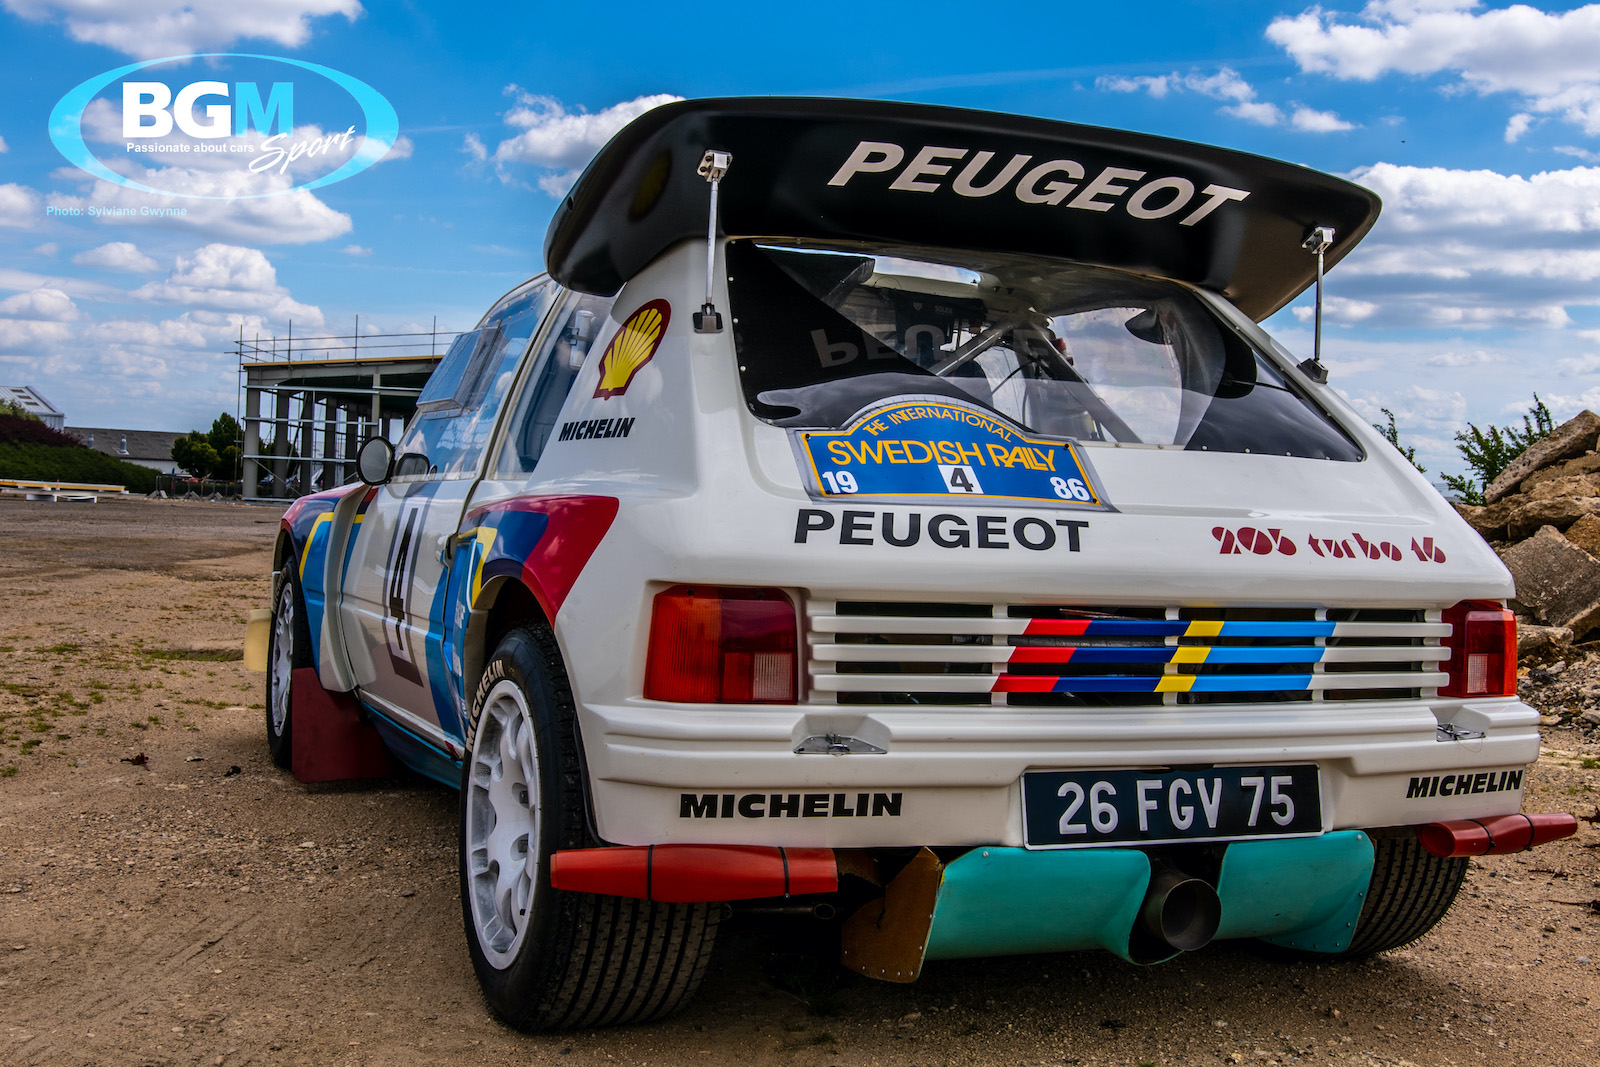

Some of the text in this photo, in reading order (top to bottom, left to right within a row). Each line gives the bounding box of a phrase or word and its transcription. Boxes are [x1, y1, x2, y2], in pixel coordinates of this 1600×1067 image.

[827, 140, 1251, 227] PEUGEOT
[558, 417, 636, 442] MICHELIN
[863, 407, 1013, 443] THE INTERNATIONAL
[827, 440, 1056, 472] SWEDISH RALLY
[821, 467, 1090, 502] 19 4 86
[794, 508, 1090, 553] PEUGEOT
[1211, 526, 1447, 564] 205 turbo 16
[466, 659, 506, 753] MICHELIN
[1405, 769, 1524, 799] MICHELIN
[679, 792, 903, 819] MICHELIN
[1056, 775, 1295, 835] 26 FGV 75
